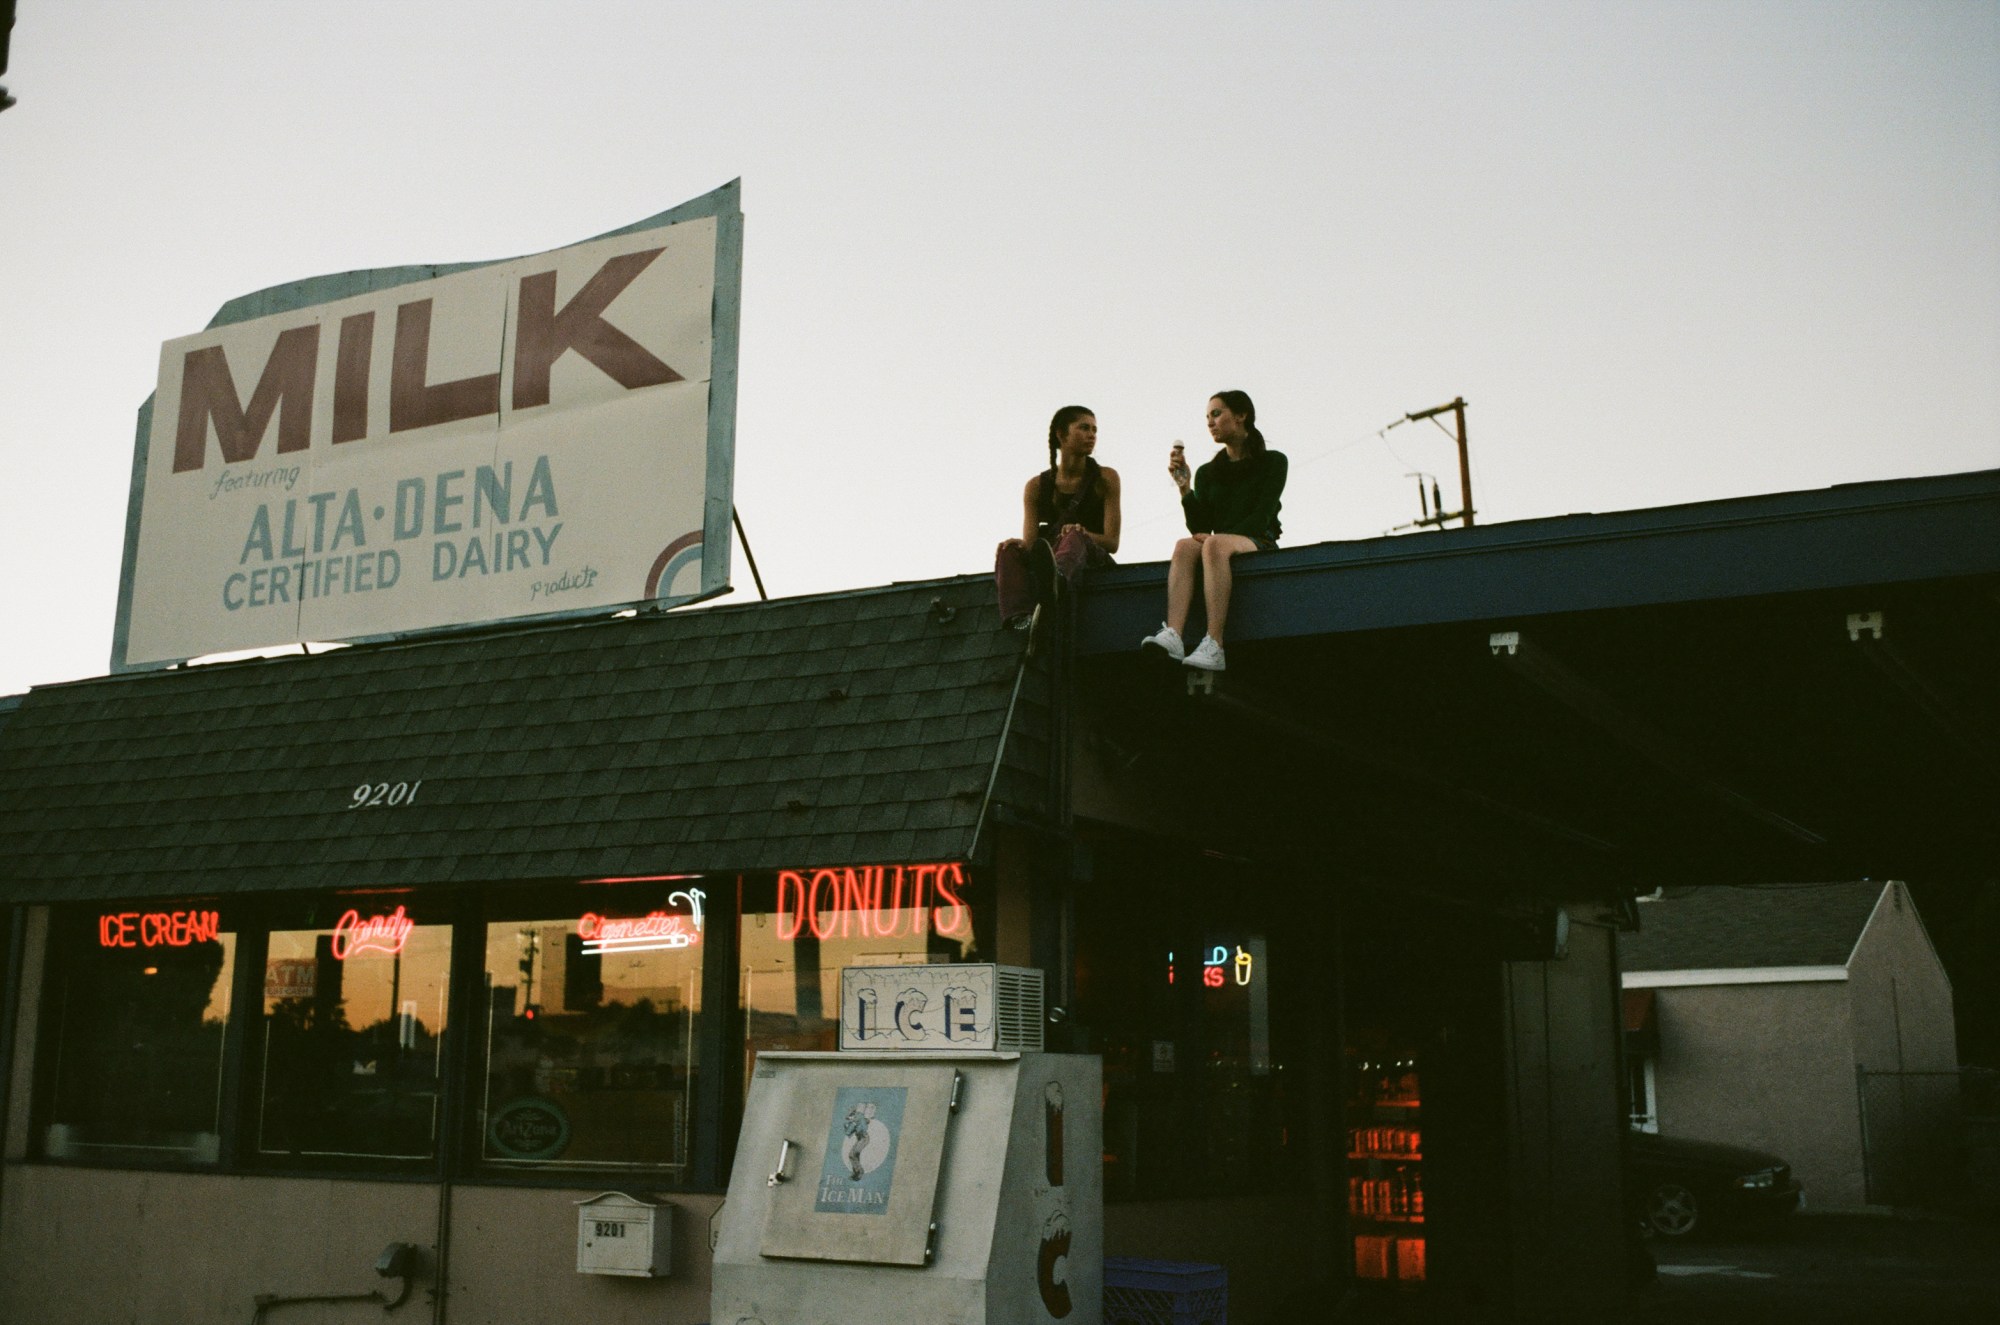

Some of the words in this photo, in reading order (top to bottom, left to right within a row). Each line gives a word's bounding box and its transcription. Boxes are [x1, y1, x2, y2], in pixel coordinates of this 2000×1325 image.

[172, 246, 686, 474] MILK
[209, 466, 300, 500] featuring
[222, 549, 401, 612] CERTIFIED
[432, 524, 564, 582] DAIRY
[348, 780, 422, 809] 9201
[99, 911, 140, 947] ICE
[140, 909, 219, 947] CREAM
[775, 863, 965, 940] DONUTS
[331, 905, 415, 960] Candy
[856, 986, 978, 1043] ICE
[595, 1223, 626, 1237] 9201
